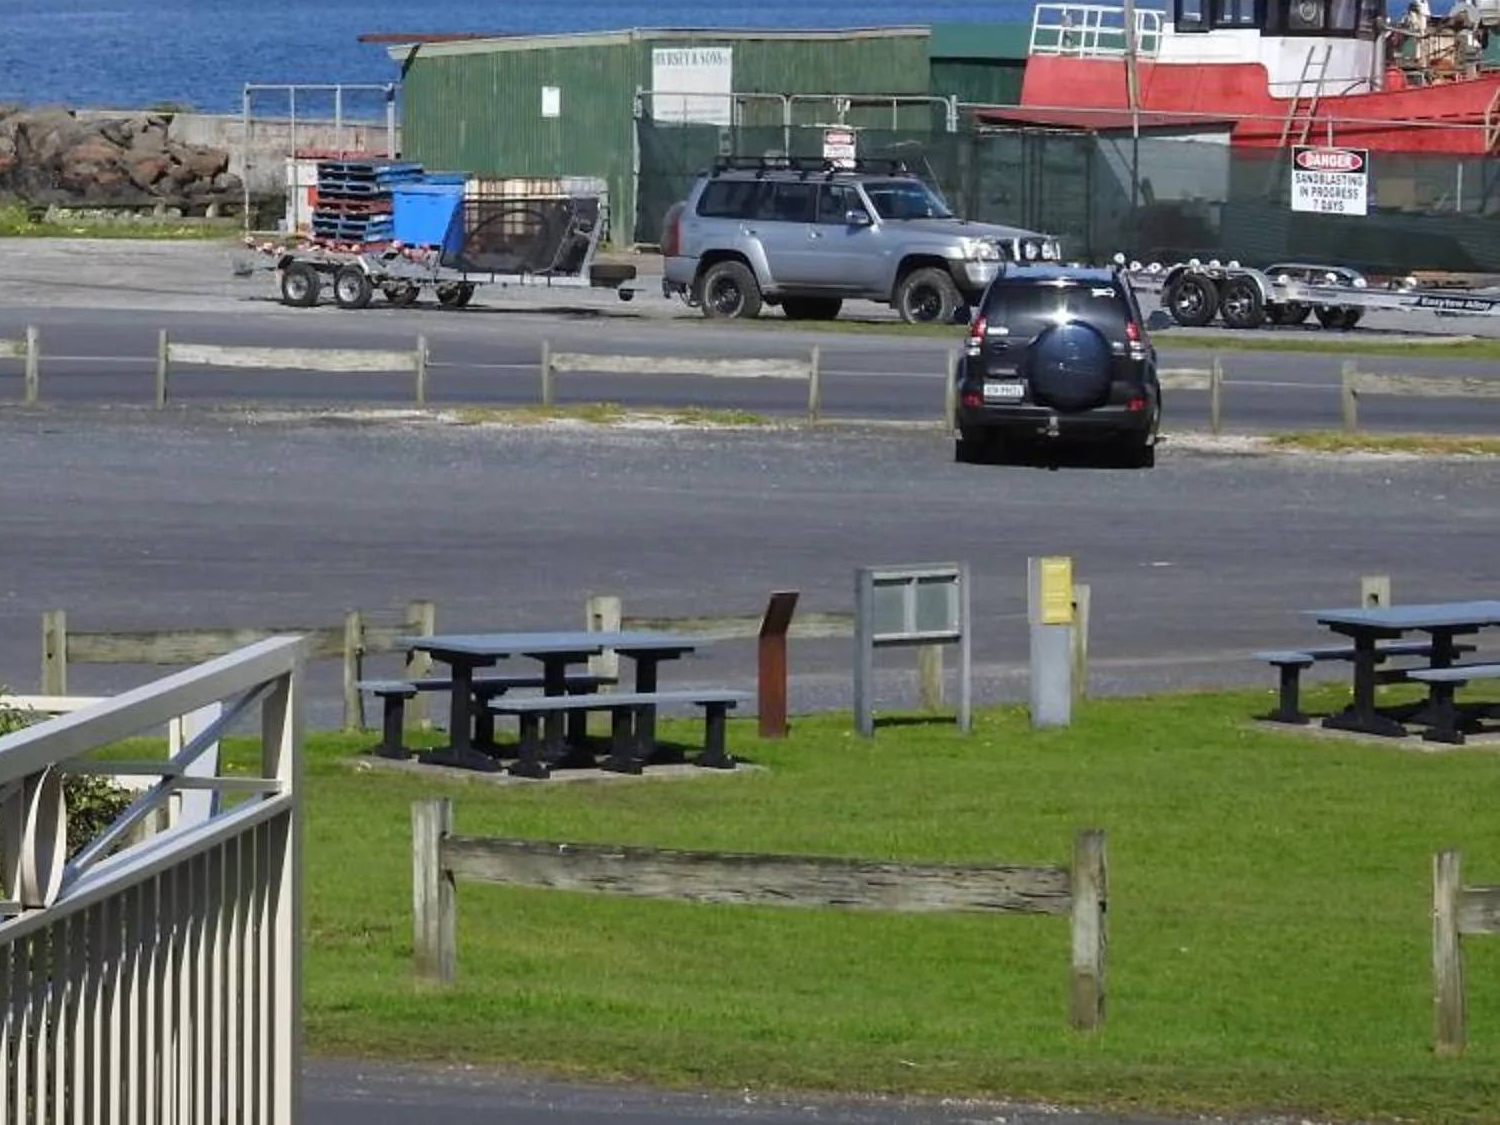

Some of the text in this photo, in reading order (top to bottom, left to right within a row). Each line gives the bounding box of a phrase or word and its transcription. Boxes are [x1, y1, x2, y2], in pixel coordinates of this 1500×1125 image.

[1304, 153, 1352, 168] DANGER
[1295, 172, 1364, 188] SANDBLASTING
[1299, 185, 1359, 200] IN PROGRESS
[1321, 199, 1345, 212] DAYS
